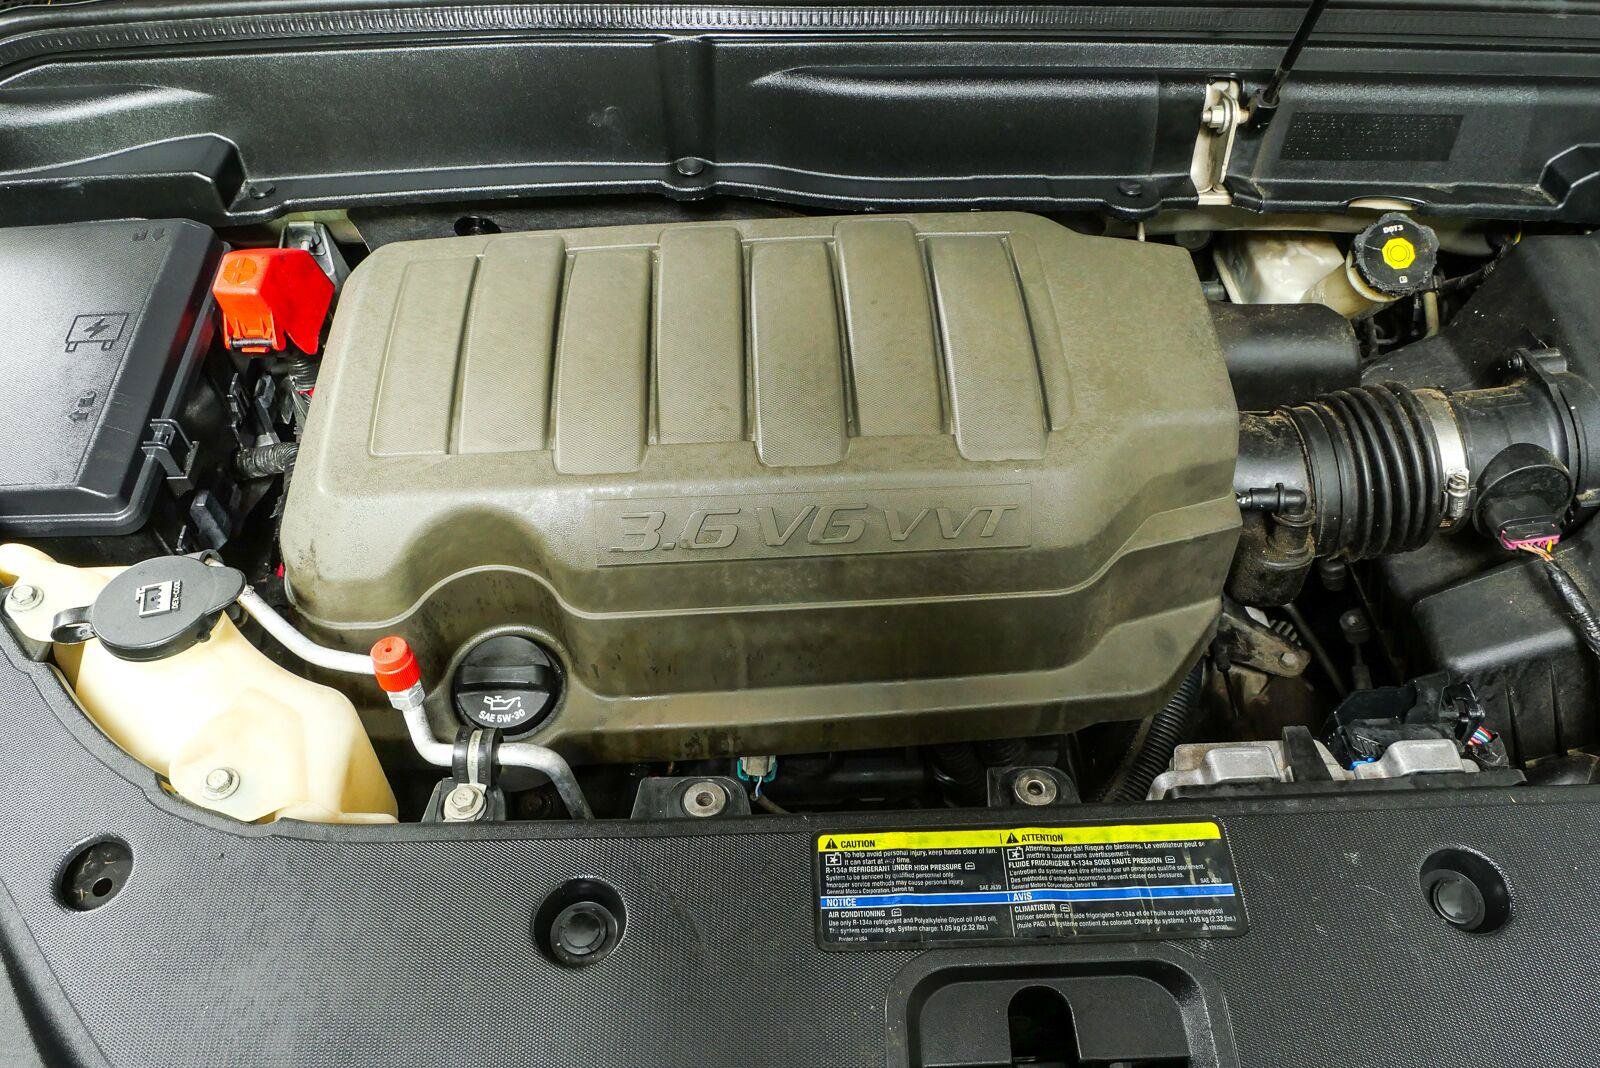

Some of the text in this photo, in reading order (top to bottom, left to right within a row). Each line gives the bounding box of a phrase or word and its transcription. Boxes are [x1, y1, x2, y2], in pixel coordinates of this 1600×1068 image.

[608, 503, 1019, 553] 3.6 V6 VVT
[478, 708, 526, 723] SAE 5W-30
[1021, 834, 1063, 842] ATTENTION
[840, 840, 876, 848] CAUTION
[1013, 892, 1032, 901] AVIS
[826, 898, 857, 907] NOTICE
[1014, 904, 1056, 913] CLIMATISEUR
